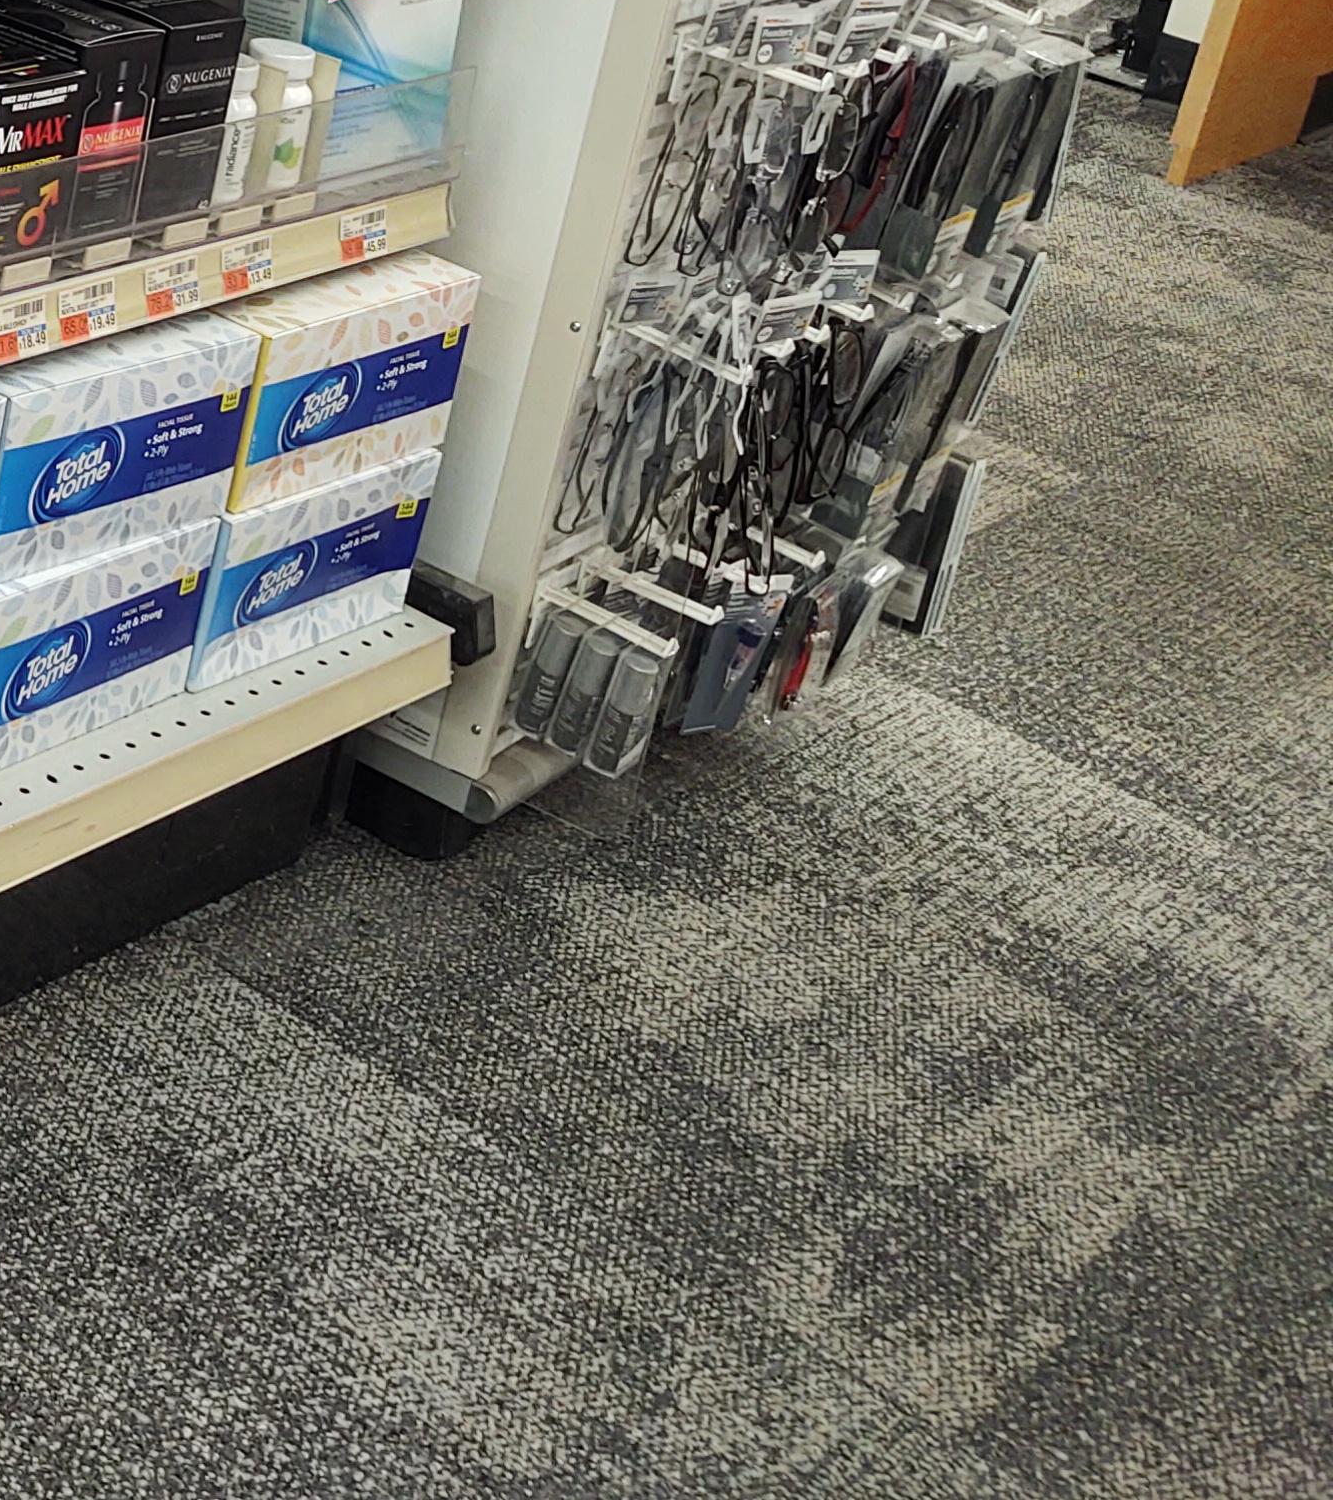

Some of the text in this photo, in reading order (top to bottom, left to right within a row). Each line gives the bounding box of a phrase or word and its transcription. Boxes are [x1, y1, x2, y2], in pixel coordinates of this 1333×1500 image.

[182, 66, 232, 88] NUGENIX
[54, 440, 105, 476] Total
[46, 458, 113, 505] Home
